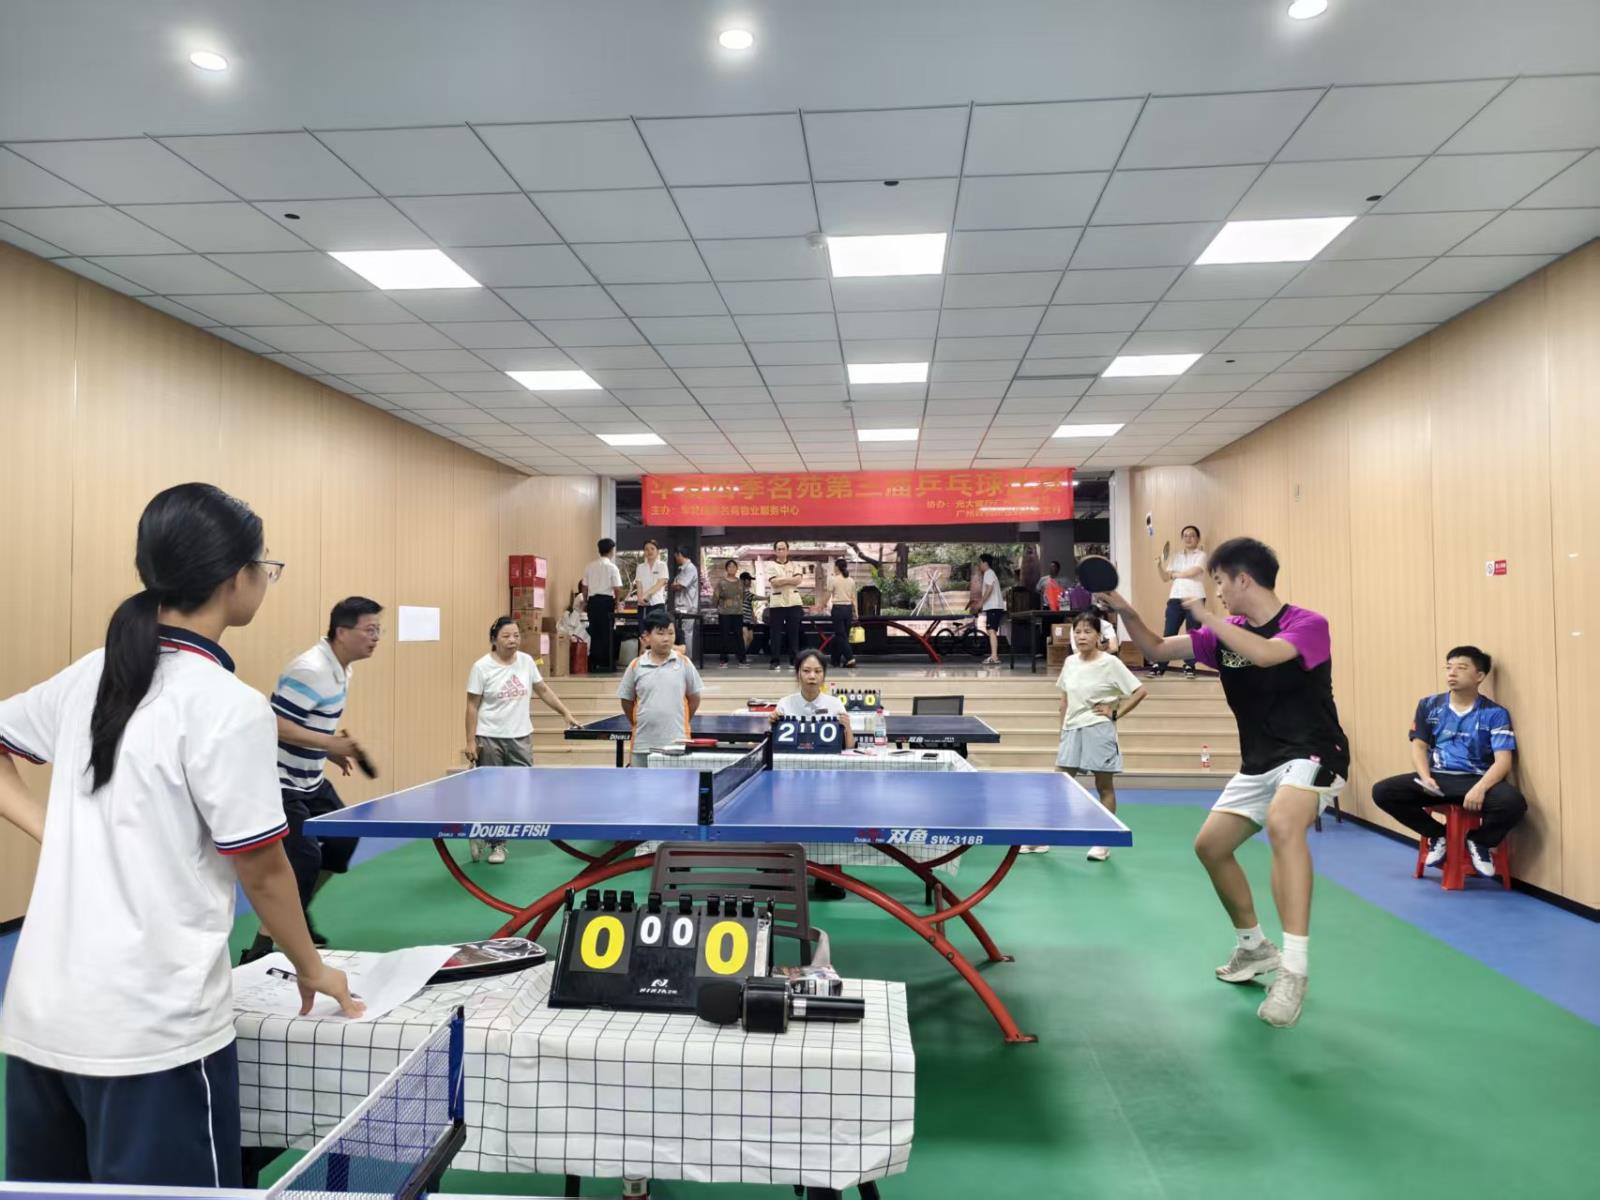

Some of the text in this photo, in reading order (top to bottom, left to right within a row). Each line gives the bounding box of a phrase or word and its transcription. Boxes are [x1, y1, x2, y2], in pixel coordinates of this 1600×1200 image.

[778, 723, 837, 743] 2 1 1 0
[469, 823, 520, 838] DOUBLE
[521, 824, 550, 837] FISH
[887, 829, 928, 844] 双鱼
[930, 835, 983, 845] SW-318B
[580, 915, 748, 975] 0 0 0 0
